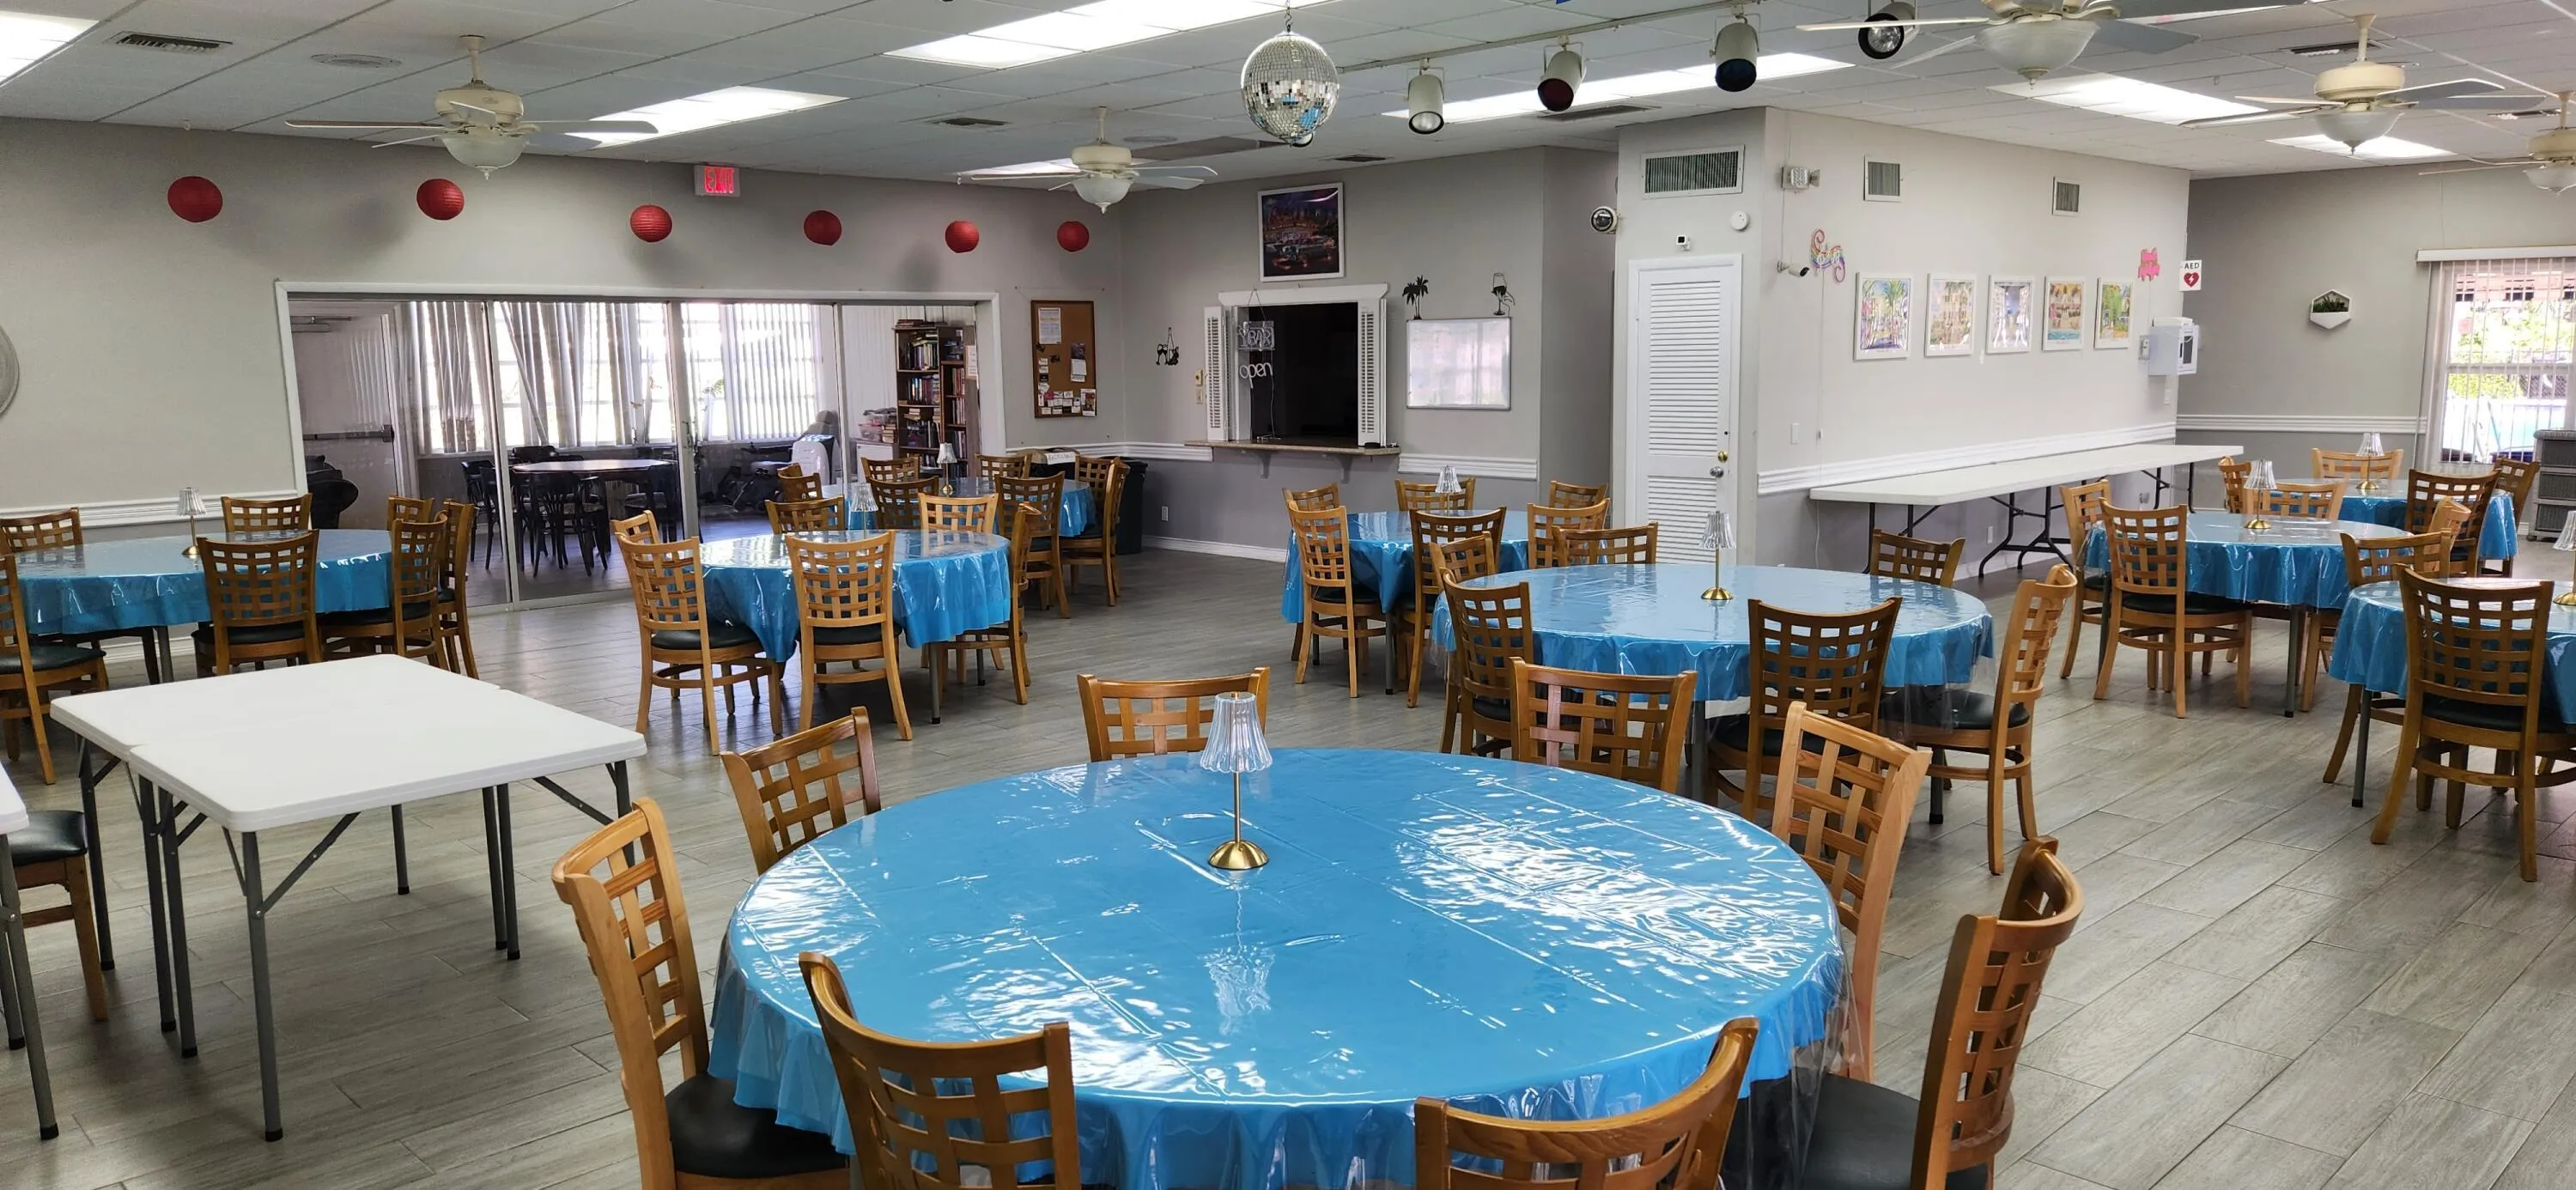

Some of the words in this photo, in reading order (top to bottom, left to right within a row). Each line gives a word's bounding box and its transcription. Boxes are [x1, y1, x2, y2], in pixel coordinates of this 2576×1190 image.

[704, 167, 734, 193] EXIT
[2184, 262, 2200, 270] AED
[1248, 330, 1271, 346] BAR
[1239, 362, 1273, 389] open
